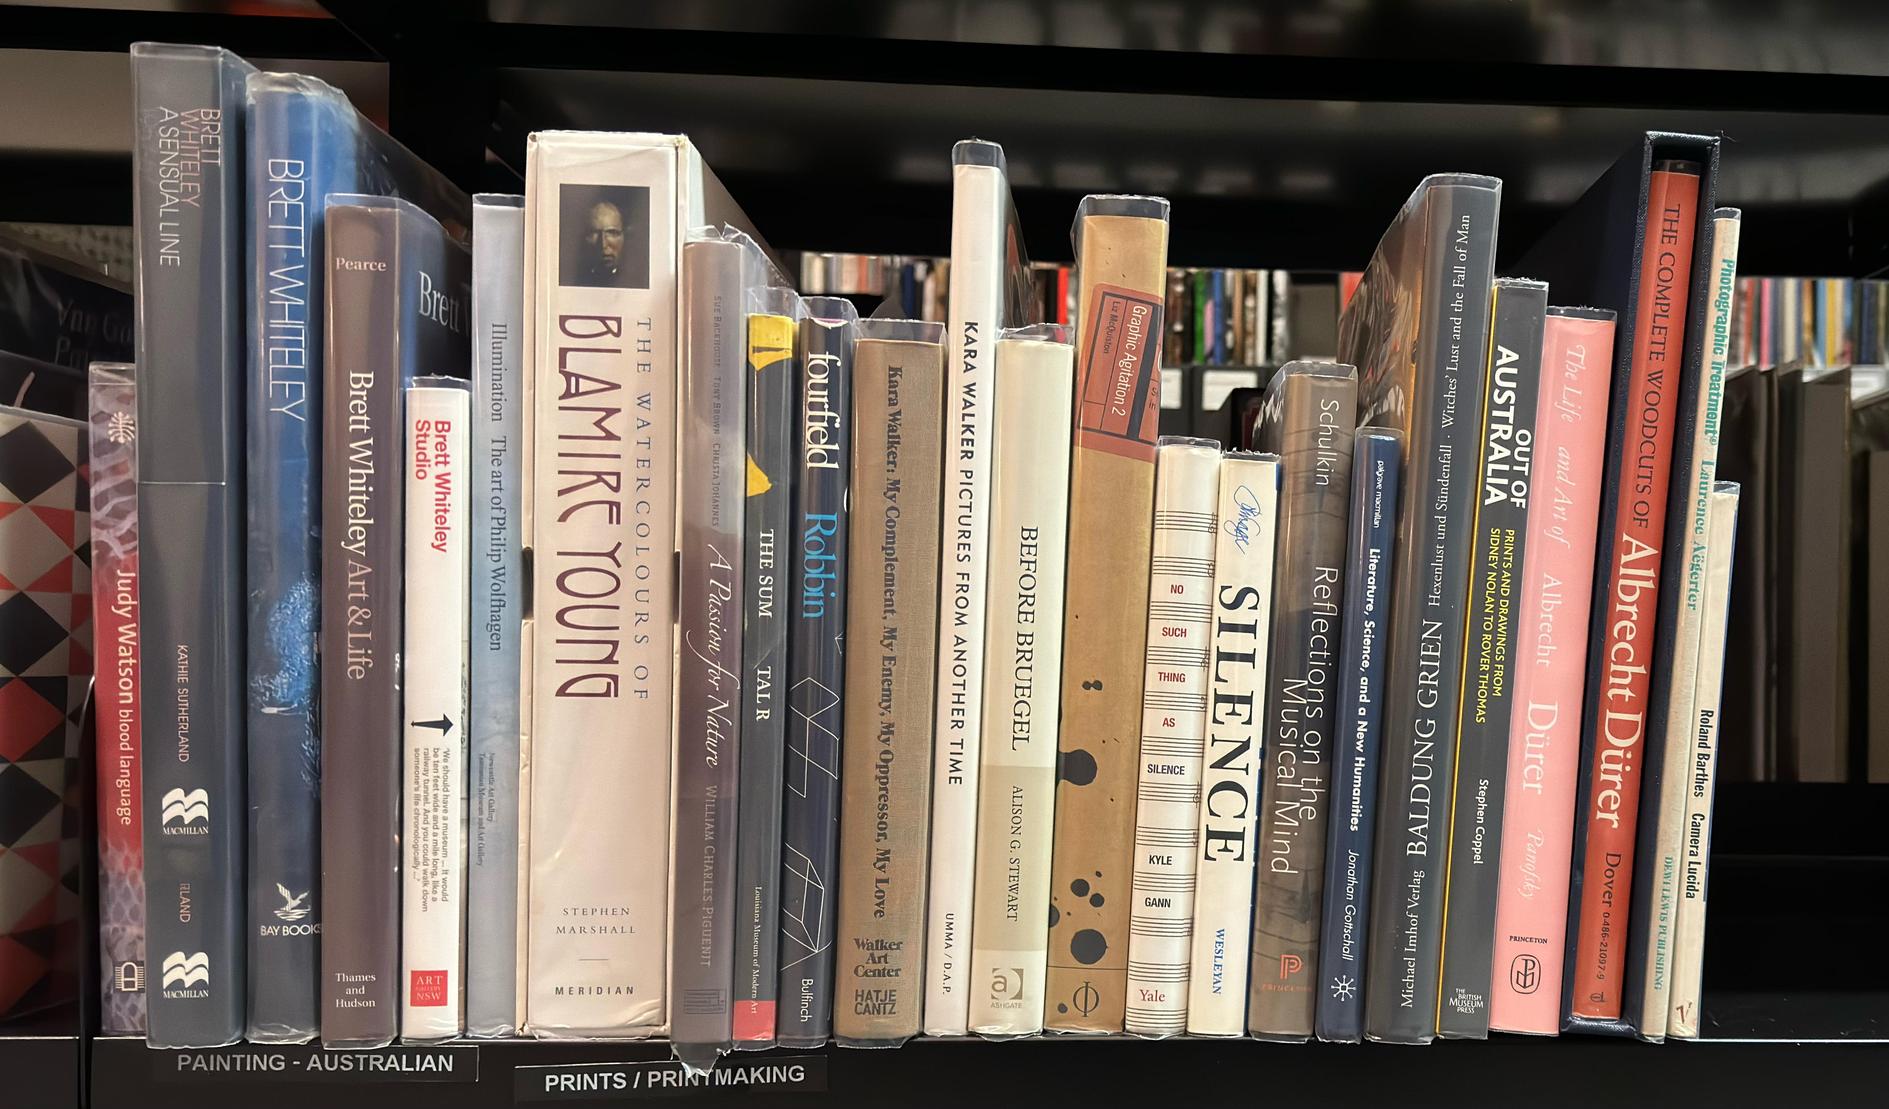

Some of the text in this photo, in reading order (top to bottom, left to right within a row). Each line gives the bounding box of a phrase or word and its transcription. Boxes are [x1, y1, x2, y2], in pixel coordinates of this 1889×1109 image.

[180, 109, 201, 208] WHITELEY
[200, 109, 220, 167] BRETT
[159, 126, 180, 267] SENSUAL LINE
[268, 159, 306, 421] BRETT WHITELEY
[335, 256, 387, 273] Pearce
[1452, 266, 1466, 288] Fall
[1713, 258, 1735, 355] Photographic
[490, 323, 508, 422] Illumination
[1114, 305, 1148, 405] Graphic Agitation
[1446, 344, 1460, 371] Lust
[1635, 252, 1676, 495] COMPLETE WOODCUTS
[806, 351, 842, 470] fourfield
[1315, 399, 1340, 486] Schulkin
[1484, 345, 1520, 506] AUSTRALIA
[1554, 384, 1584, 423] Life
[415, 420, 431, 480] Studio
[431, 420, 452, 553] Brett Whiteley
[1373, 460, 1385, 528] palgrave macmillan
[1435, 445, 1452, 511] Sündenfall
[341, 371, 375, 680] Brett Whiteley Life
[555, 314, 622, 699] BLAMIRE YOUNG
[634, 392, 651, 644] WATERCOLOURS
[1687, 460, 1715, 611] Laurence Aëgerter
[486, 516, 507, 651] Philip Wolfhagen
[758, 575, 773, 618] SUM
[803, 512, 838, 618] Robbin
[948, 321, 979, 785] KARA WALKER PICTURES FROM ANOTHER TIME
[1428, 544, 1445, 607] Hexenlust
[873, 365, 903, 920] Kara Walker: Complement, Enemy, Oppressor, Love
[1011, 526, 1039, 751] BEFORE BRUEGEL
[1161, 627, 1187, 638] SUCH
[1306, 566, 1339, 719] Reflections
[1475, 528, 1500, 723] SIDNEY NOLAN ROVER THOMAS
[1492, 529, 1515, 697] PRINTS DRAWINGS FROM
[112, 569, 138, 825] Judy Watson blood language
[177, 645, 190, 762] KATHIE SUTHERLAND
[704, 578, 732, 769] Passion Nature
[1158, 672, 1186, 683] THING
[1350, 548, 1381, 831] Literature, Science, Humanities
[1595, 532, 1660, 829] Albrecht Dürer
[1147, 764, 1185, 775] SILENCE
[1204, 585, 1260, 862] SILENCE
[1406, 619, 1443, 857] BALDUNG GRIEN
[1518, 572, 1563, 897] Albrecht Dürer Panofsky
[1270, 678, 1308, 874] Musical Mind
[1472, 779, 1489, 864] Stephen Coppel
[1685, 710, 1715, 899] Roland Barthes Camera Lucida
[162, 826, 209, 835] MACMILLAN
[700, 785, 718, 968] WILLIAM CHARLES PIGUENIT
[1006, 785, 1023, 921] ALISON STEWART
[1149, 855, 1172, 866] KYLE
[556, 925, 636, 935] MARSHALL
[562, 906, 631, 917] STEPHEN
[751, 886, 763, 998] Louisiana Museum Modern
[854, 938, 903, 952] Walker
[1144, 897, 1171, 908] GANN
[1341, 849, 1360, 961] Jonathan Gottschall
[1400, 870, 1425, 1008] Michael Imhof Verlag
[1509, 935, 1548, 944] PRINCETON
[1596, 852, 1621, 980] Dover 0-486-21097-9
[1654, 856, 1674, 990] DEWI LEWIS PUBLISHING
[162, 990, 209, 998] MACMILLAN
[335, 972, 376, 984] Thames
[416, 975, 444, 985] ART
[416, 991, 441, 1000] NSW
[555, 985, 635, 996] MERIDIAN
[800, 978, 814, 1022] Bulfinch
[853, 965, 901, 979] Center
[855, 989, 897, 1003] HATJE
[942, 913, 955, 995] UMMA D.A.P.
[1140, 989, 1166, 1003] Yale
[1212, 928, 1225, 995] WESLEYAN
[335, 997, 376, 1009] Hudson
[854, 1002, 897, 1016] CANTZ
[1449, 998, 1484, 1009] MUSEUM
[1457, 1006, 1475, 1014] PRESS
[177, 1053, 454, 1073] PAINTING AUSTRALIAN
[544, 1071, 626, 1093] PRINTS
